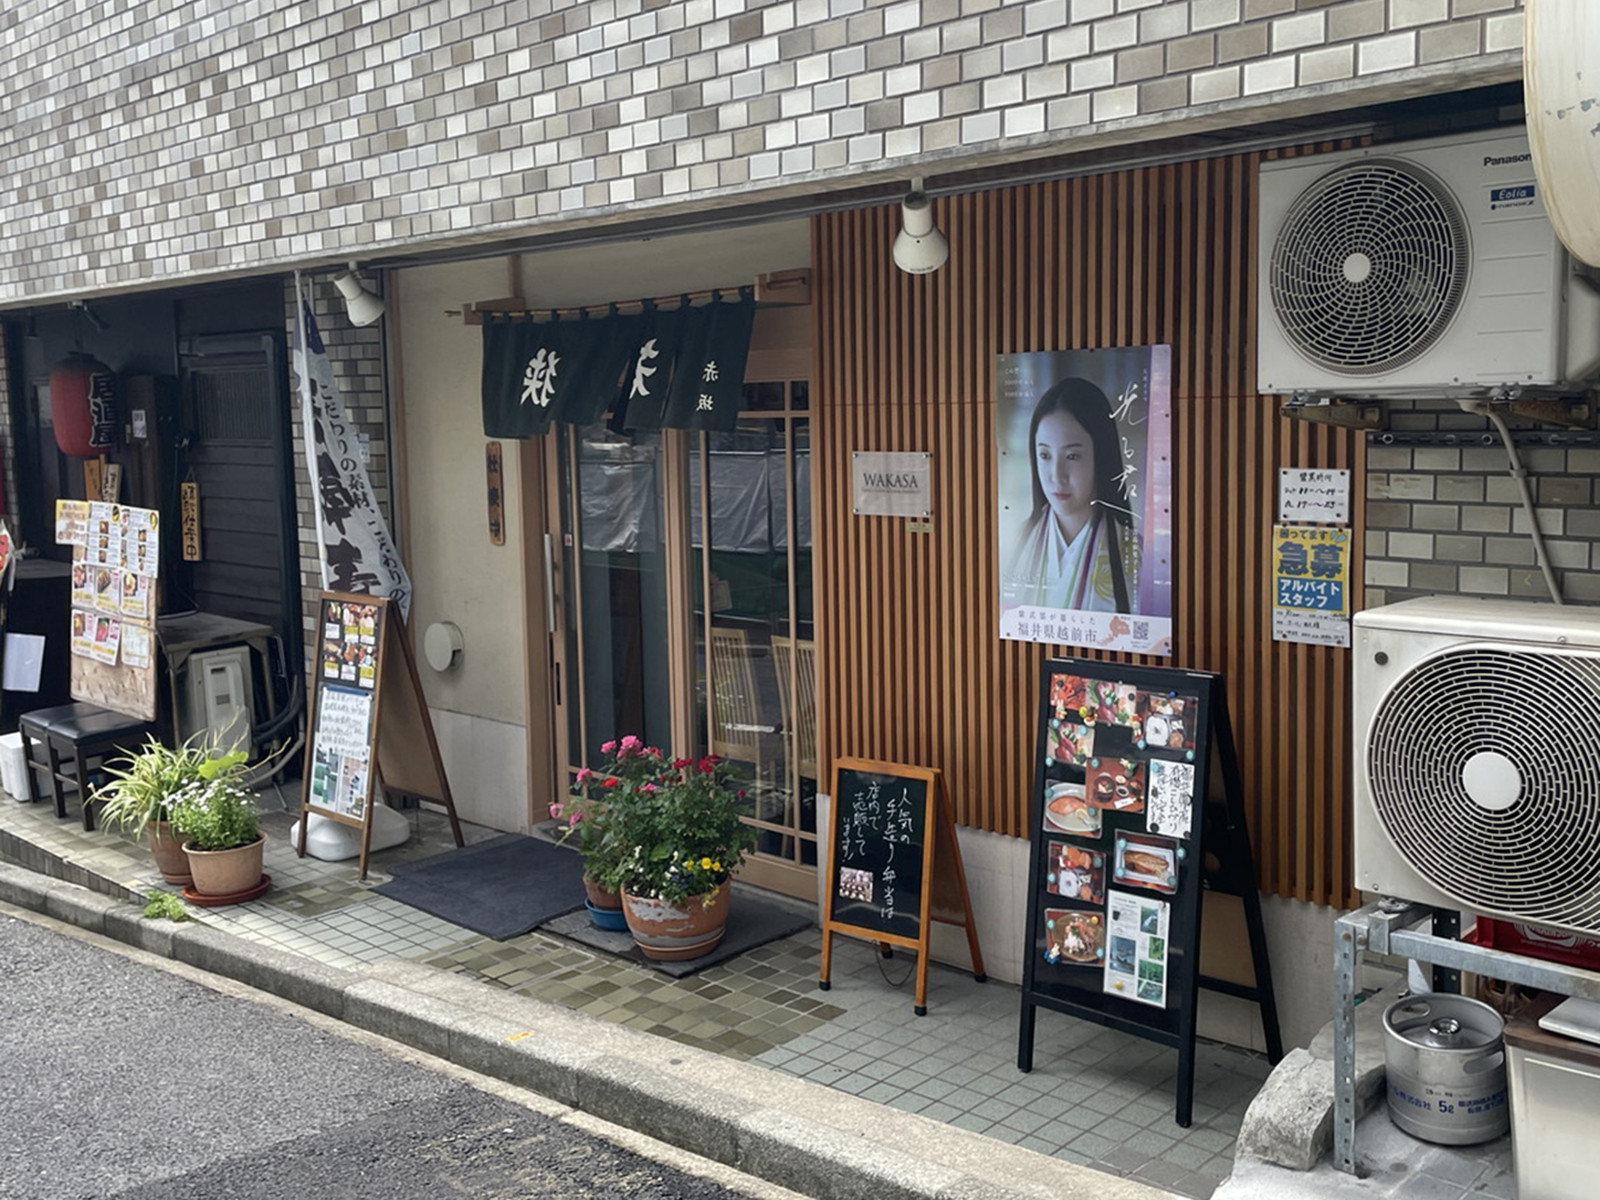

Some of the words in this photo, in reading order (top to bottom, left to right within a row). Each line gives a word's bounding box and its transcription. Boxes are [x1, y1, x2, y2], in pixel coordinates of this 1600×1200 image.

[1483, 152, 1532, 167] Panason
[1498, 188, 1527, 200] Eolia
[1090, 381, 1147, 519] 光る君へ
[863, 472, 918, 488] WAKASA
[1279, 528, 1328, 540] 困ってます
[1278, 541, 1343, 578] 急募
[1280, 579, 1340, 597] アルバイト
[1280, 592, 1328, 608] スタッフ
[1018, 622, 1097, 643] 福井県越前市
[866, 781, 882, 831] 店内で
[897, 787, 914, 845] 人気の
